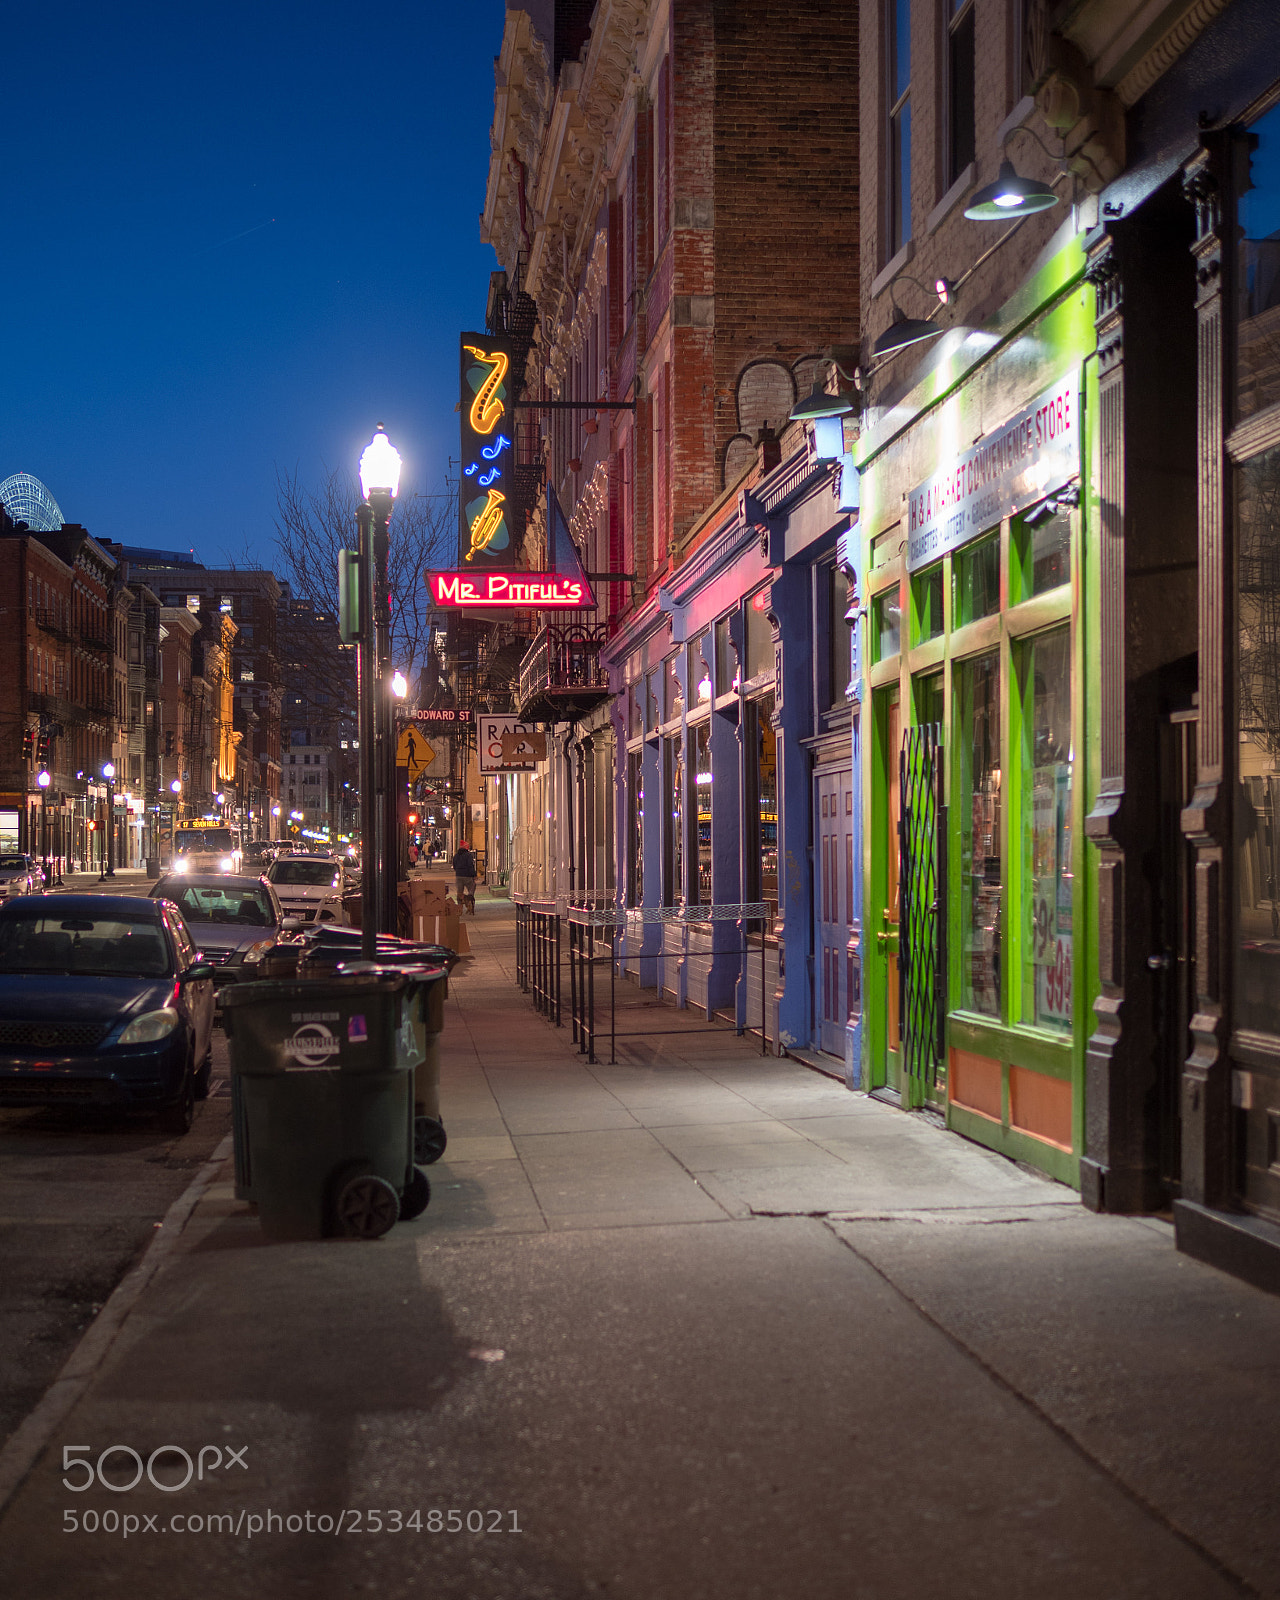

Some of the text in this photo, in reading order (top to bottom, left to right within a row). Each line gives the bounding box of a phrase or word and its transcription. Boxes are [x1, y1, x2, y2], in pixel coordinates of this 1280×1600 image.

[911, 498, 917, 532] H
[918, 494, 924, 527] &
[926, 489, 932, 523] A
[967, 416, 1032, 496] CONVENIENCE
[1035, 390, 1070, 449] STORE
[413, 710, 455, 721] ODWARD
[459, 711, 471, 721] ST
